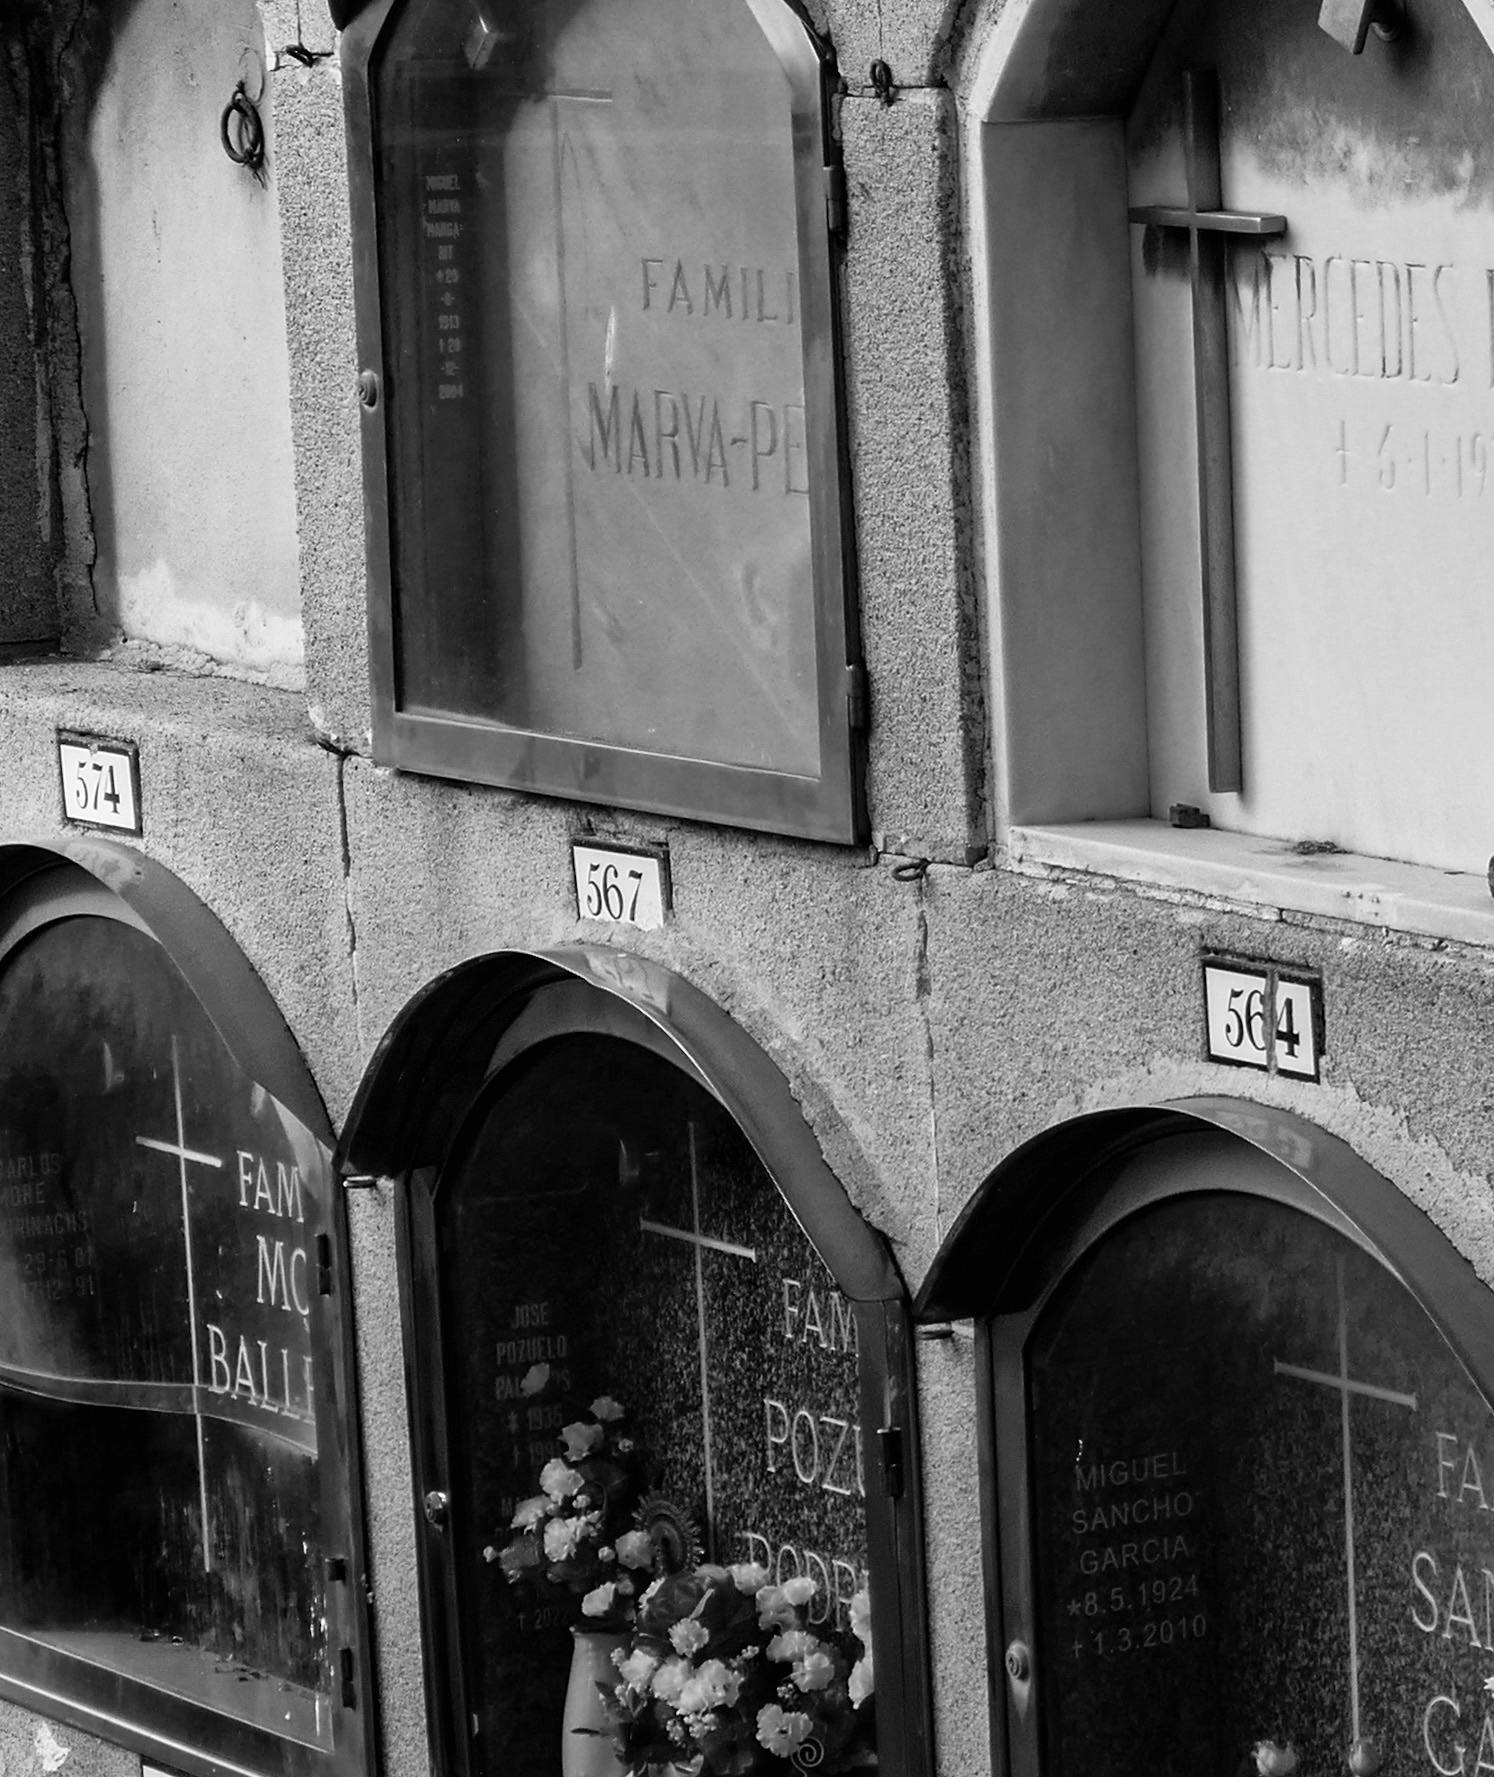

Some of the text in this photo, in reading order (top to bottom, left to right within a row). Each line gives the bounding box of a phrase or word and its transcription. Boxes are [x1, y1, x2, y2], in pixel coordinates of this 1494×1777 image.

[78, 761, 120, 816] 574
[586, 864, 643, 921] 567
[1226, 987, 1301, 1059] 564
[495, 1335, 568, 1366] POZUELO
[1075, 1451, 1188, 1491] MIGUEL
[1072, 1491, 1193, 1534] SANCHO
[1080, 1535, 1190, 1575] GARCIA
